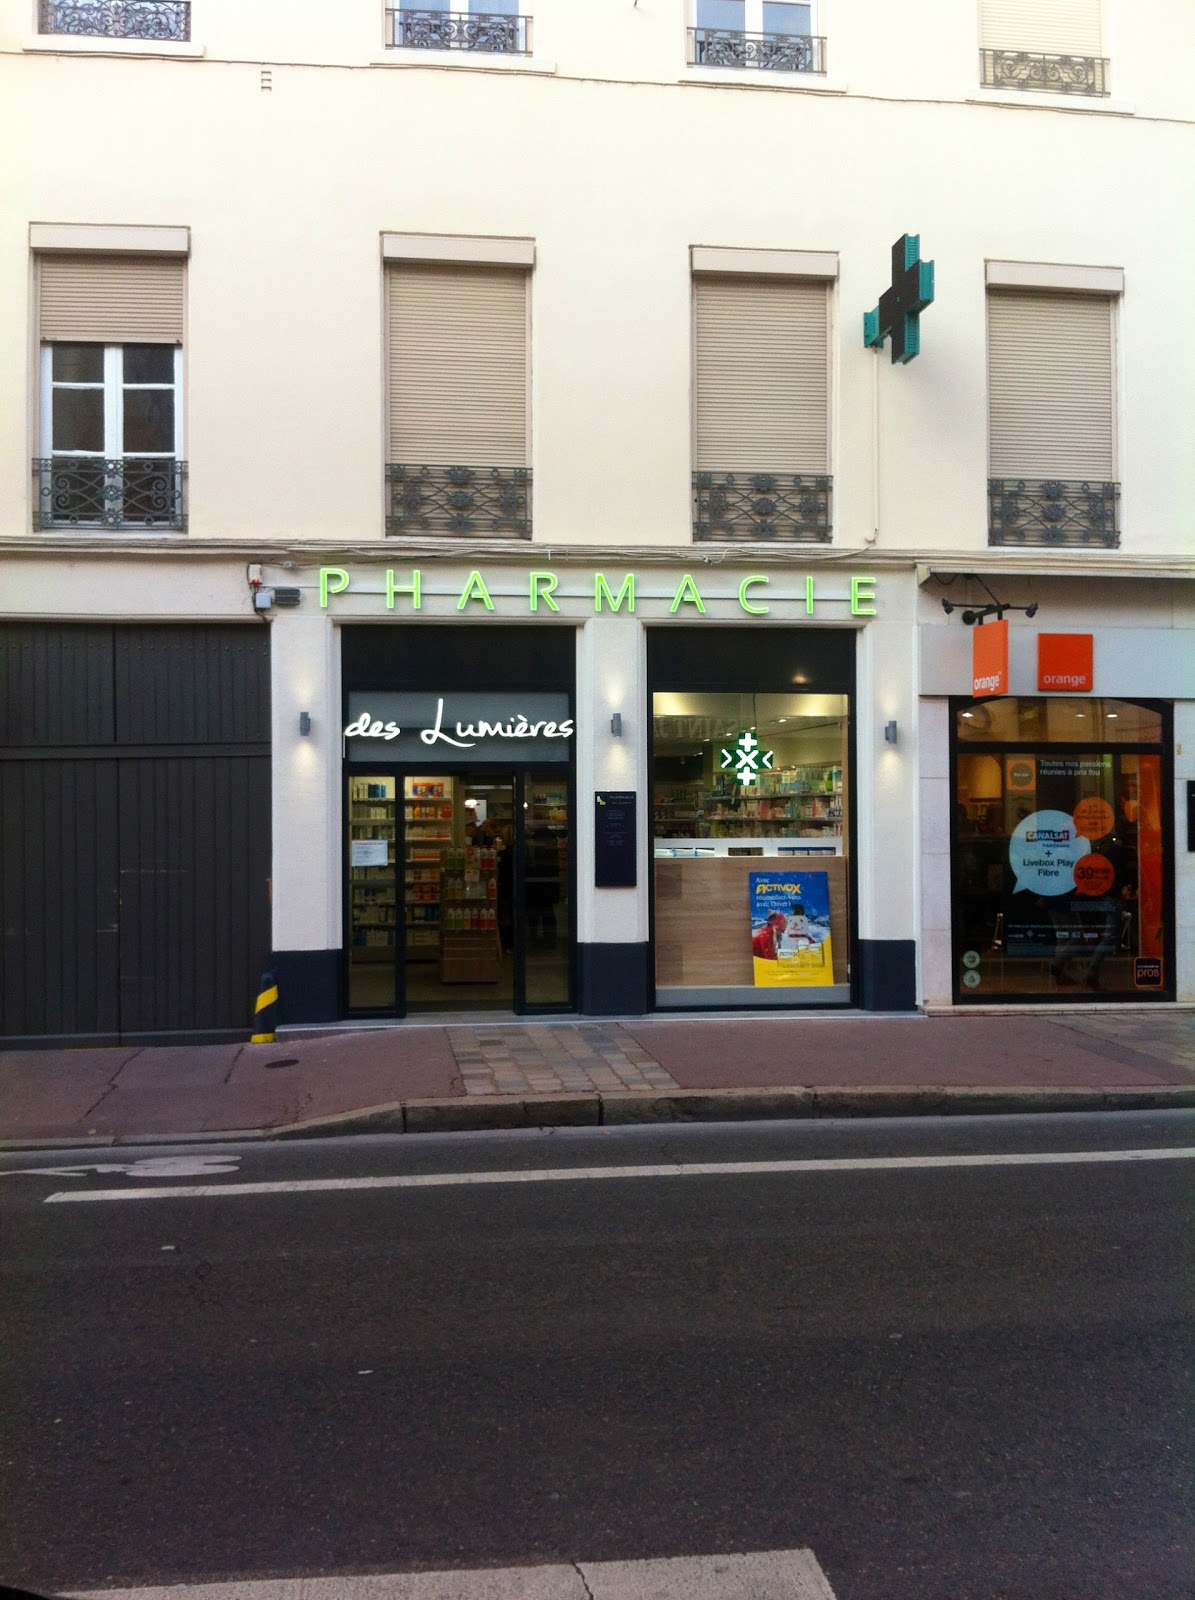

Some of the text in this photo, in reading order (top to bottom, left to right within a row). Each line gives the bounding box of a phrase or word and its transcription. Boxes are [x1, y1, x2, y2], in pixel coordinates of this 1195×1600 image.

[319, 567, 877, 615] PHARMACIE
[974, 674, 1000, 692] orange
[1043, 674, 1086, 687] orange
[344, 698, 575, 748] des Lumières
[1040, 760, 1064, 768] Toutes
[1079, 760, 1112, 769] passions
[1039, 768, 1066, 777] réunies
[1074, 769, 1087, 778] prix
[1088, 769, 1100, 777] fou
[1027, 832, 1068, 841] CANALSAT
[1023, 859, 1075, 869] Livebox Play
[1038, 868, 1060, 877] Fibre
[1077, 867, 1094, 880] 39
[756, 883, 801, 894] ACTIVOX
[1137, 968, 1160, 979] pros
